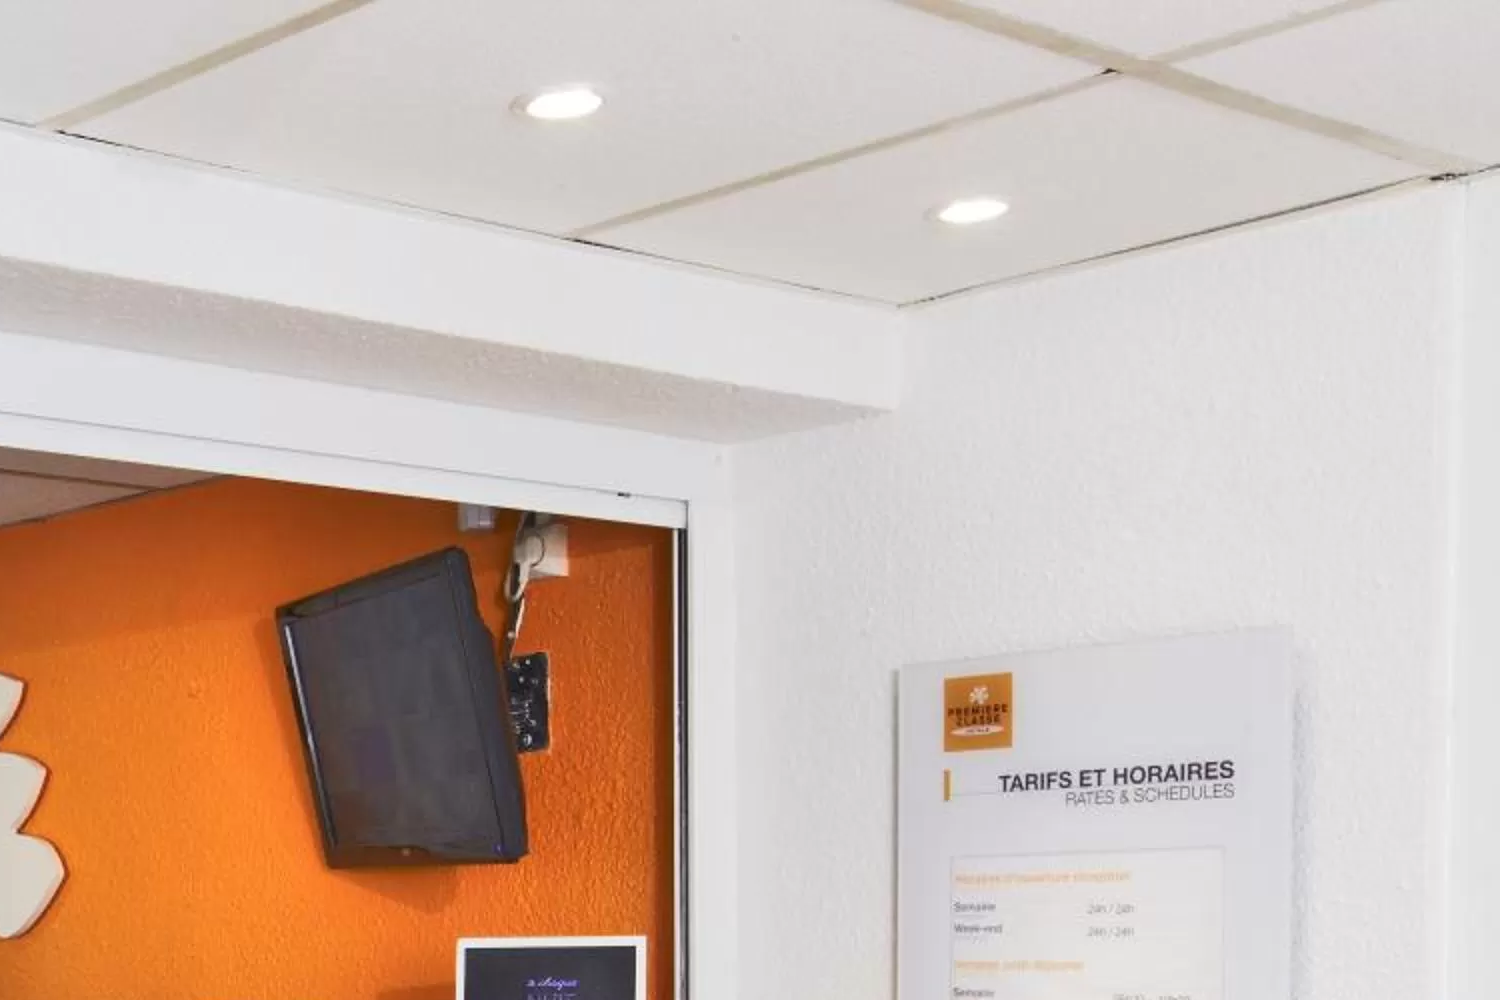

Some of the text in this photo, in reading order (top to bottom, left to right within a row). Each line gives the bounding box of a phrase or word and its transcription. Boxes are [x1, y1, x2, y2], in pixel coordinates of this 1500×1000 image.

[948, 703, 1009, 718] PREMIERE
[956, 715, 1001, 728] CLASSE
[997, 760, 1235, 793] TARIFS ET HORAIRES
[1065, 782, 1235, 809] RATES & SCHEDULES
